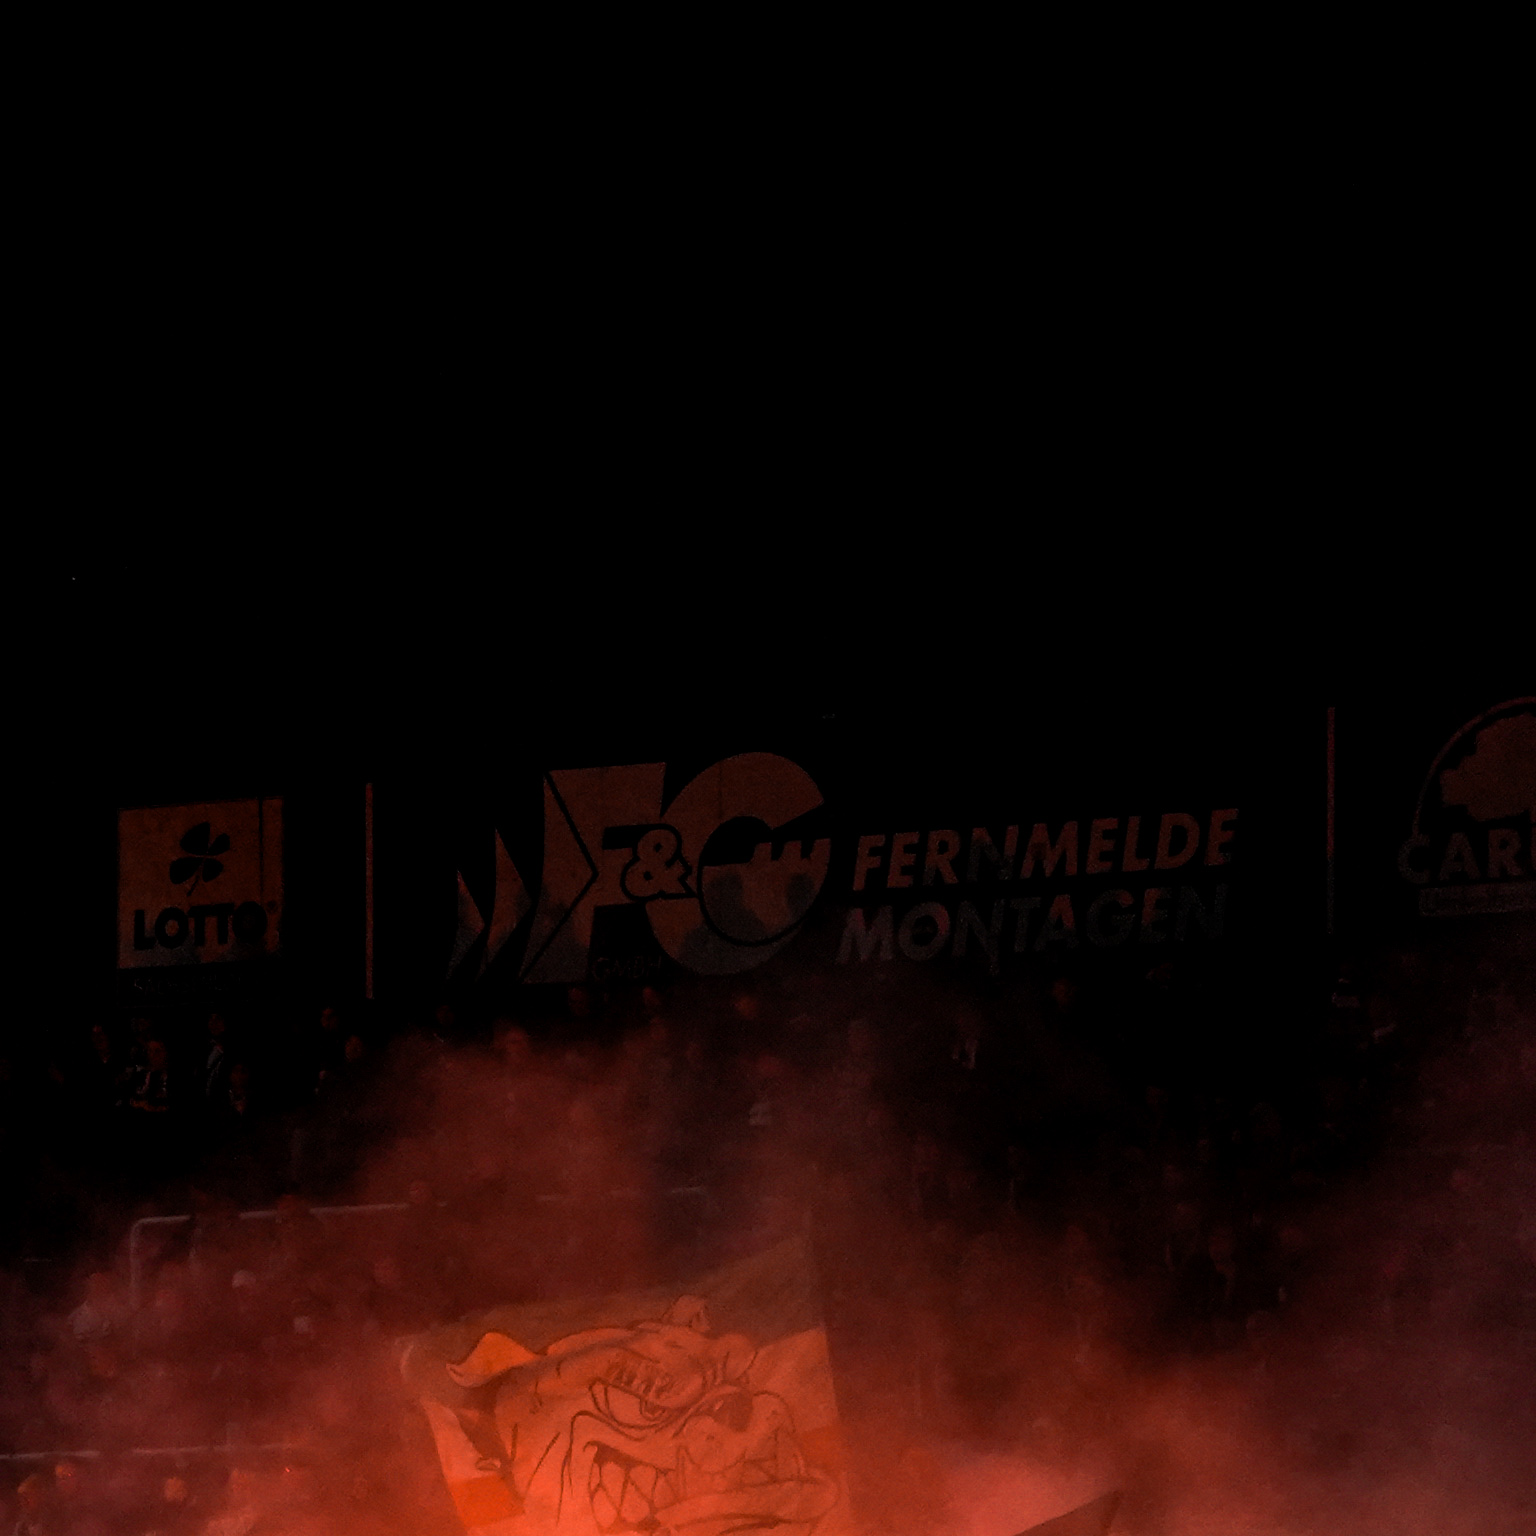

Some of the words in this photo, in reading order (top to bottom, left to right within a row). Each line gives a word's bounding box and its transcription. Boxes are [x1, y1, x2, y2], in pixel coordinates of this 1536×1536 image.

[852, 808, 1240, 892] FERNMELDE
[133, 901, 268, 950] LOTTO
[834, 882, 1230, 966] MONTAGEN
